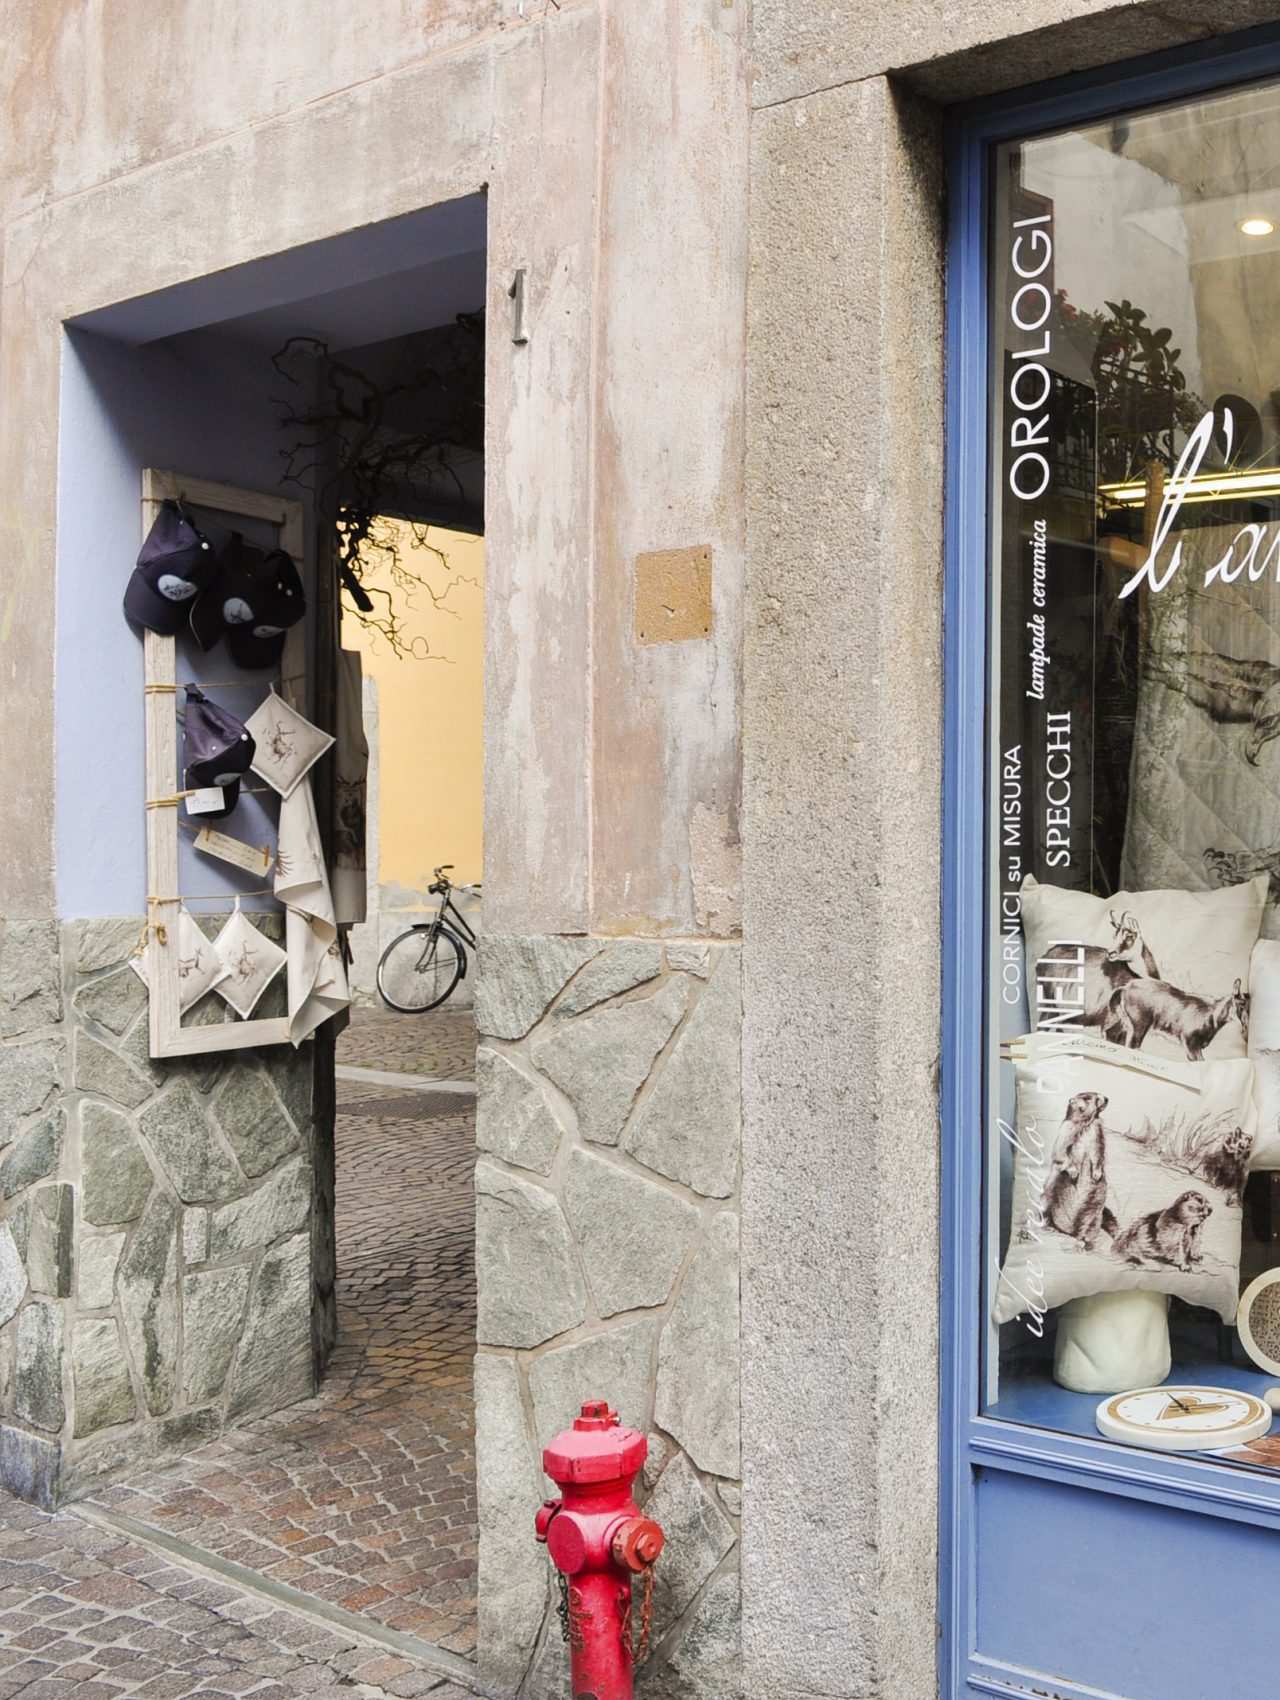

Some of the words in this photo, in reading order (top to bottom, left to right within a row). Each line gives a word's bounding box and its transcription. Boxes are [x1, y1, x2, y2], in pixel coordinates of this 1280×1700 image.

[1010, 214, 1052, 500] OROLOGI
[1029, 519, 1047, 607] ceramica
[1026, 614, 1050, 700] lampade
[1003, 744, 1022, 848] MISURA
[1046, 711, 1072, 867] SPECCHI
[1008, 855, 1022, 882] su
[1002, 888, 1022, 1005] CORNICI
